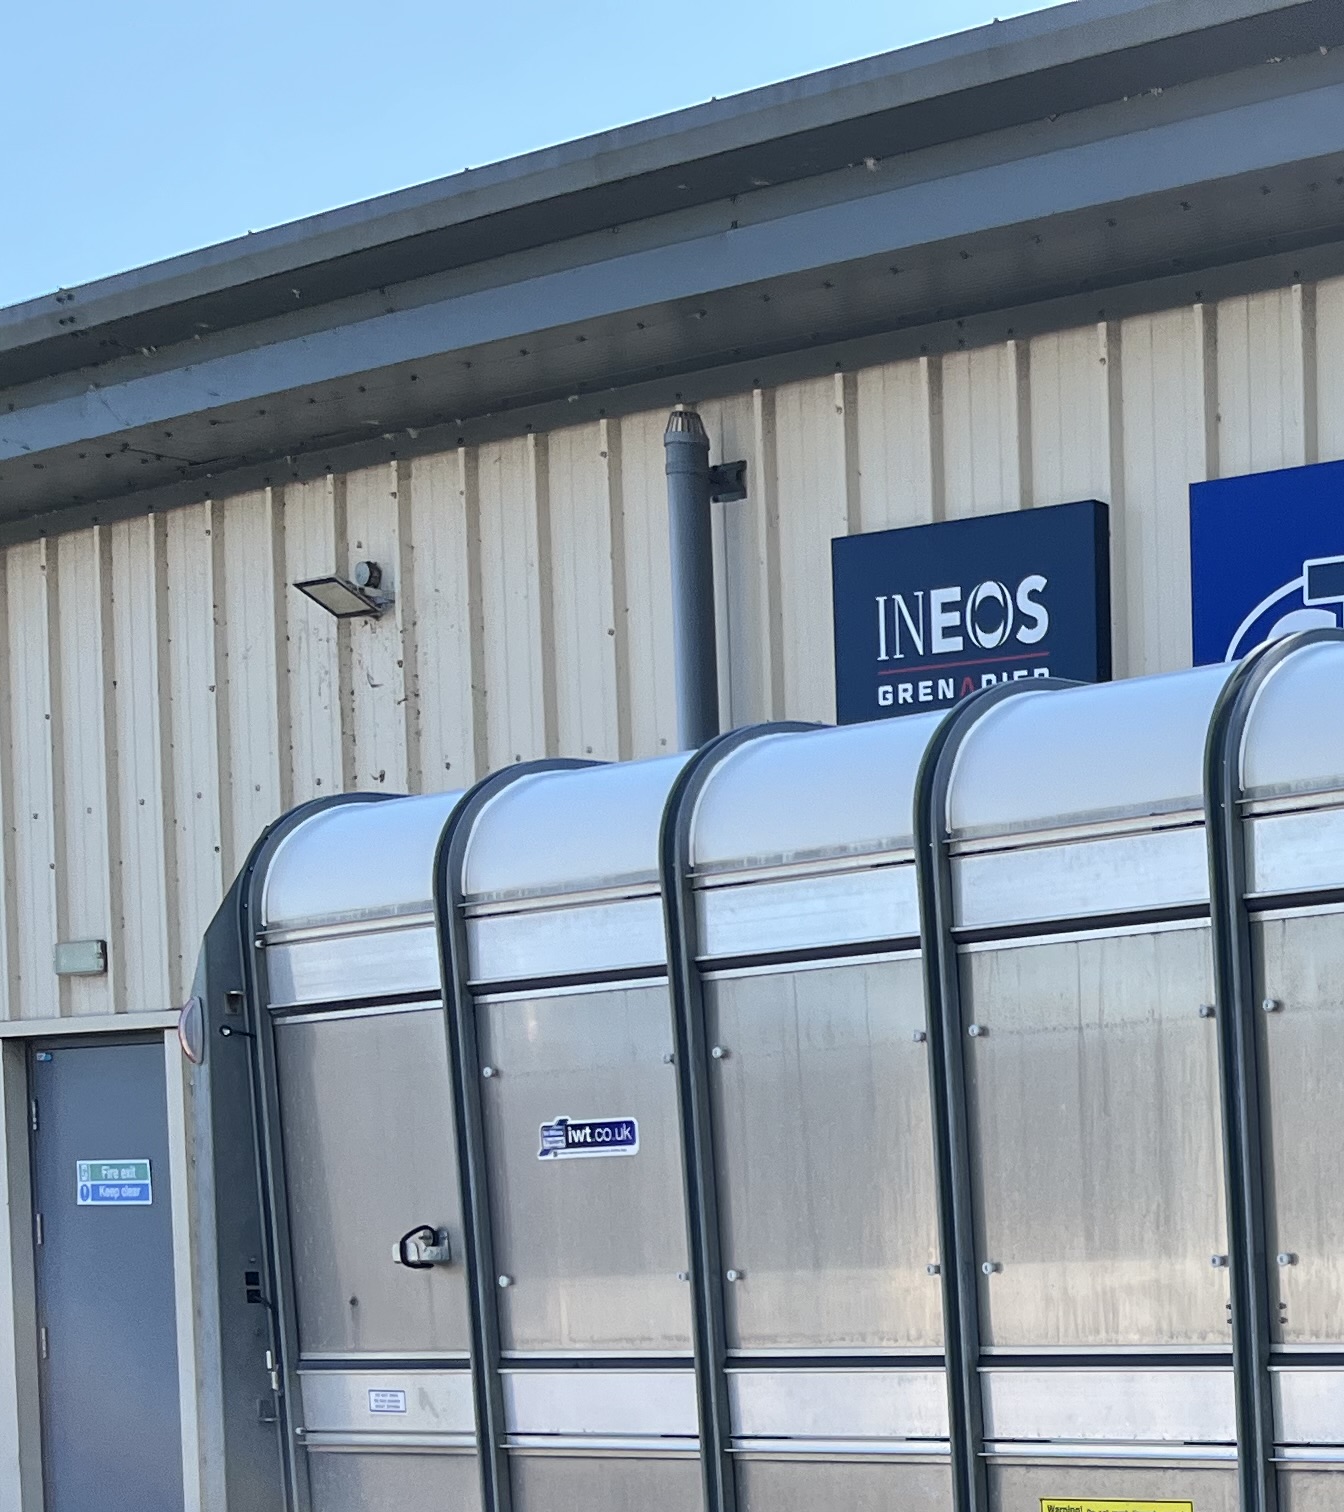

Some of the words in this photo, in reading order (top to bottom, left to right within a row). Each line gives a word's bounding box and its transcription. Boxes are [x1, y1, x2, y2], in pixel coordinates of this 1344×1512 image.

[875, 574, 1050, 661] INEOS
[567, 1122, 633, 1144] iwt.co.uk
[101, 1165, 119, 1179] Fire
[120, 1165, 136, 1179] exit
[98, 1185, 120, 1200] Keep
[121, 1184, 141, 1197] clear
